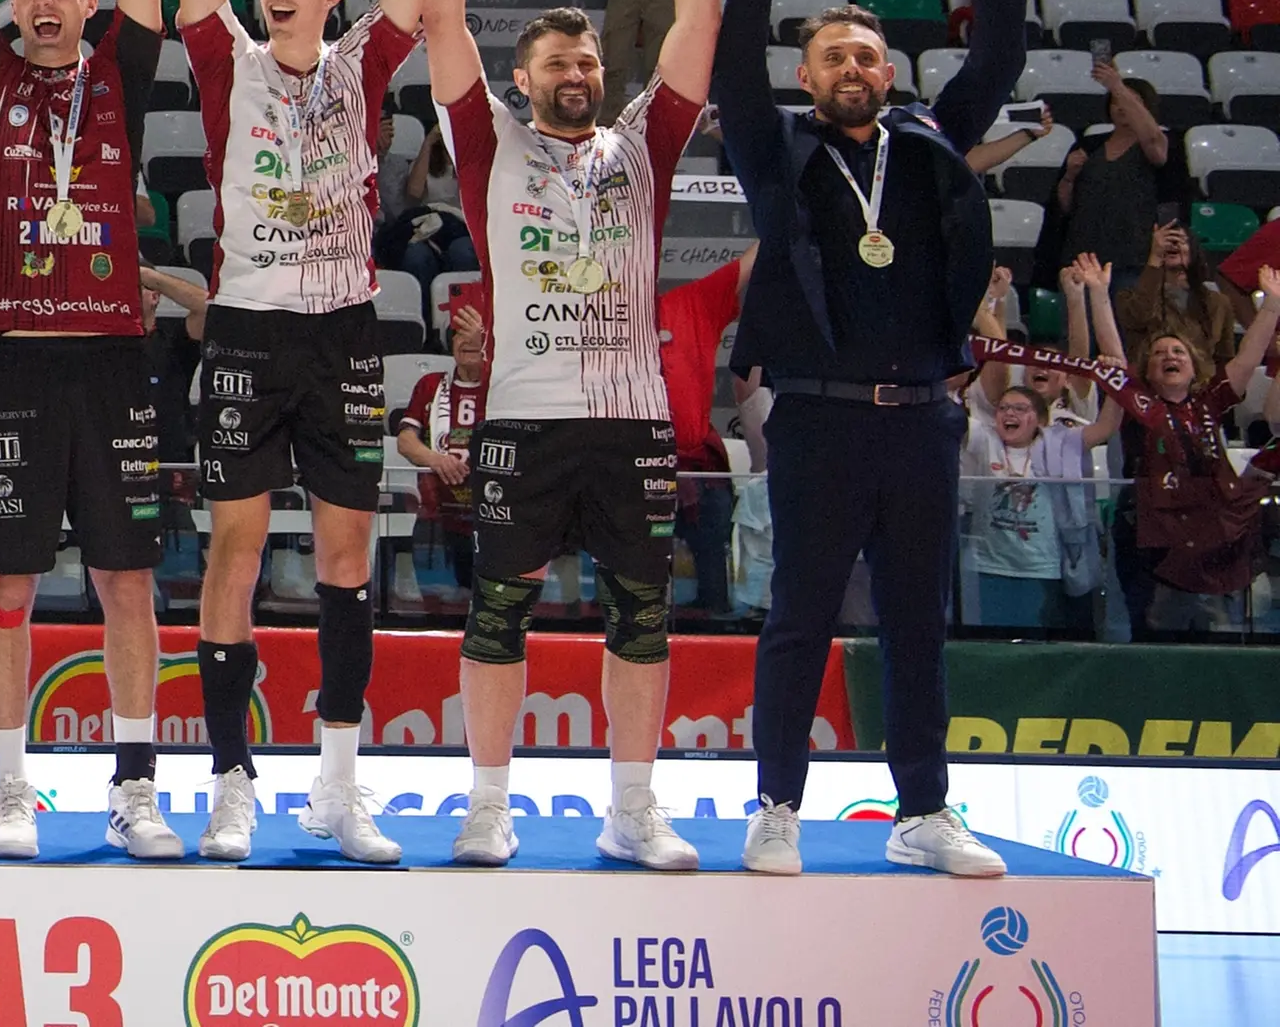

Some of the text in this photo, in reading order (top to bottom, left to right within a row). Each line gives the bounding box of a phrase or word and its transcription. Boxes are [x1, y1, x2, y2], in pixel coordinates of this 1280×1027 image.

[525, 303, 628, 322] CANALE
[555, 336, 578, 347] CTL
[582, 335, 630, 347] ECOLOGY
[457, 399, 476, 425] 6
[212, 430, 249, 445] OASI
[203, 458, 223, 483] 29
[478, 503, 512, 521] OASI
[613, 937, 715, 989] LEGA
[207, 975, 401, 1018] Del Monte
[613, 995, 841, 1027] PALLAVOLO
